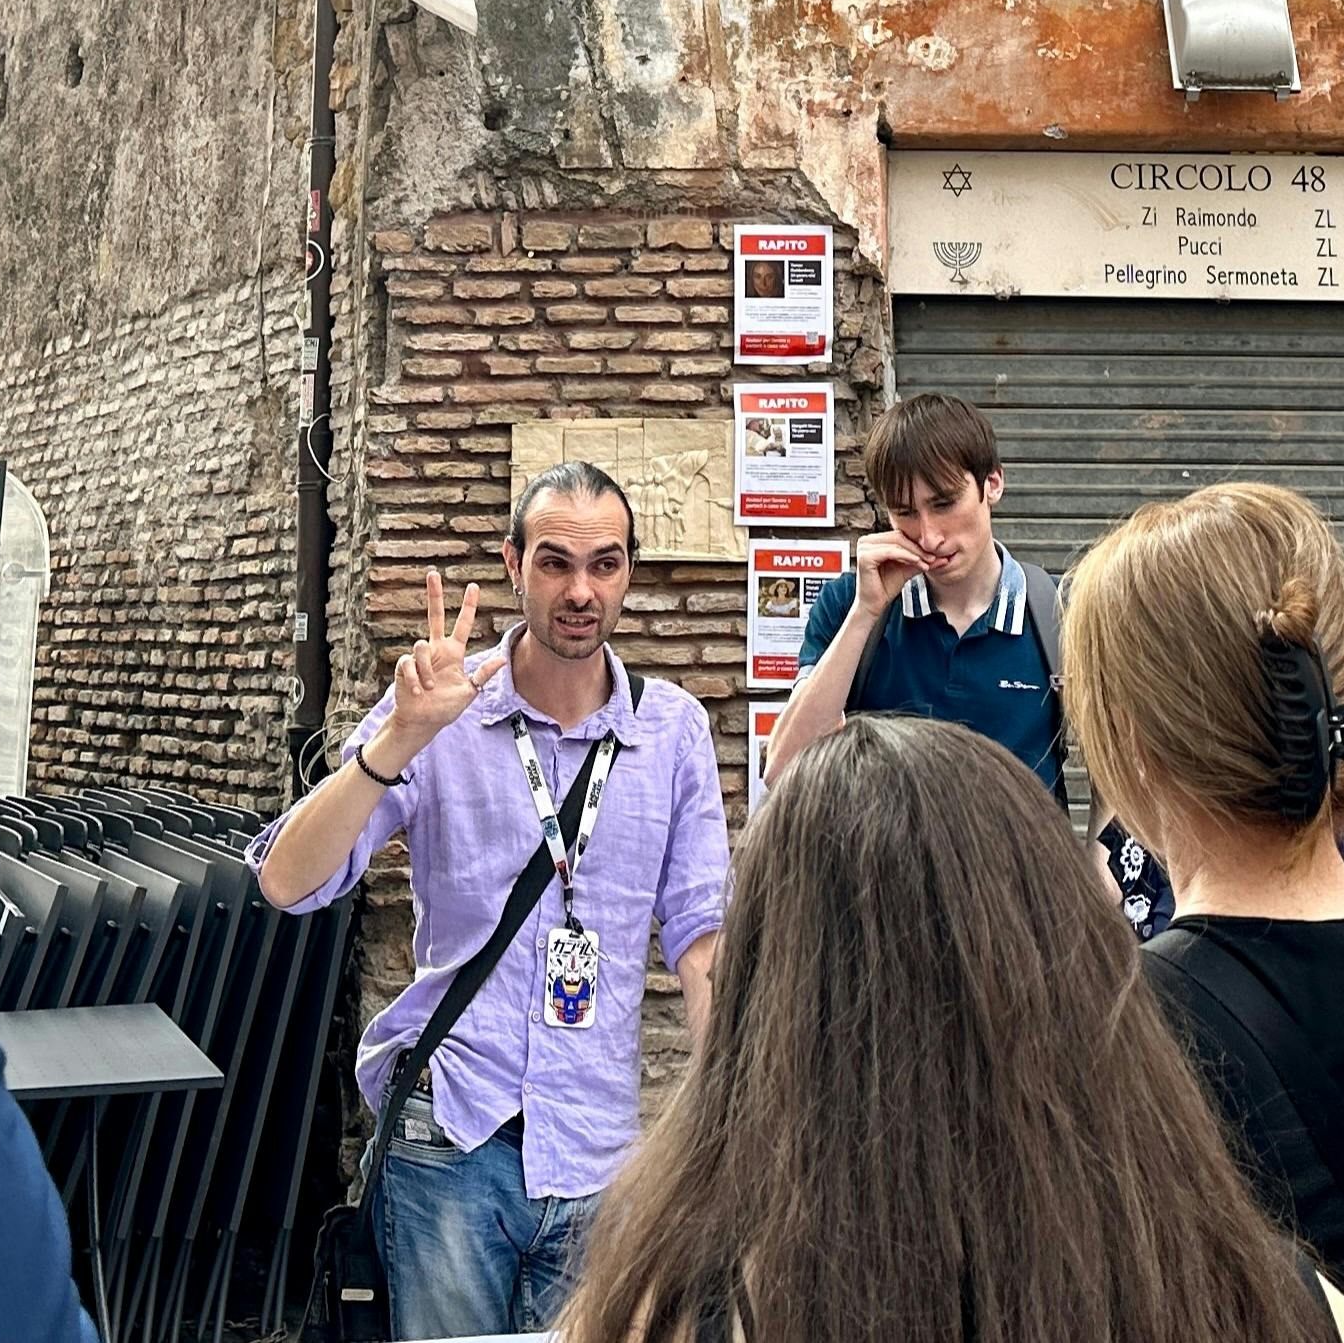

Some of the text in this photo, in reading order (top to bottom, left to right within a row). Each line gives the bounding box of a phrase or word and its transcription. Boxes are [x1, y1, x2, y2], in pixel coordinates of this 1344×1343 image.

[1110, 163, 1326, 193] CIRCOLO 48
[1142, 207, 1336, 229] Zi Raimondo ZL
[758, 239, 808, 251] RAPITO
[1178, 236, 1338, 258] Pucci ZL
[1104, 264, 1339, 289] Pellegrino Sermoneta ZL
[758, 397, 809, 409] RAPITO
[772, 555, 824, 568] RAPITO
